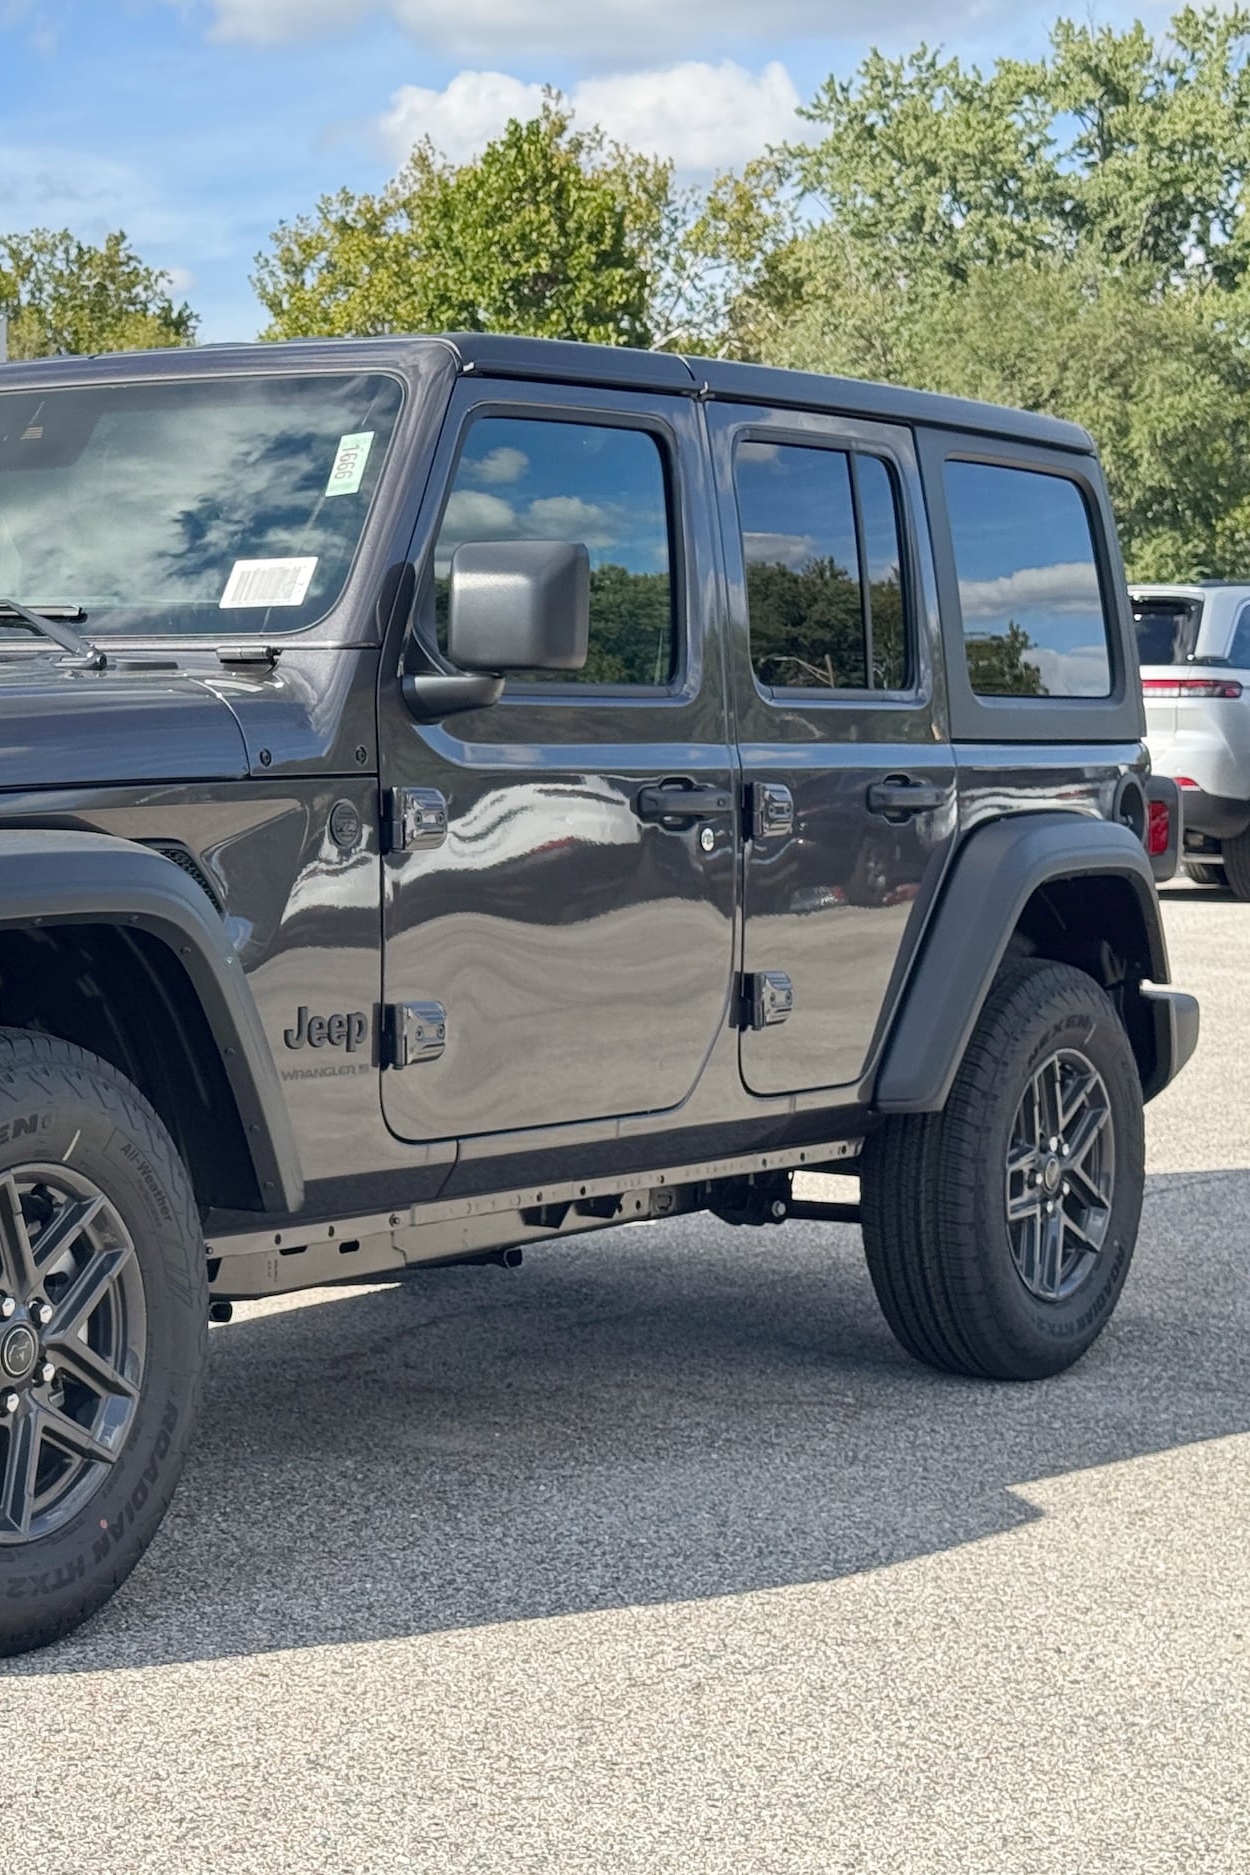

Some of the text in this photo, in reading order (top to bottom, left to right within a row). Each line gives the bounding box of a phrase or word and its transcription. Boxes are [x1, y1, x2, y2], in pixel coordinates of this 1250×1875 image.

[333, 443, 361, 480] 1666
[283, 1006, 369, 1053] Jeep
[279, 1064, 356, 1081] WRANGLER
[120, 1143, 172, 1221] All-Weather
